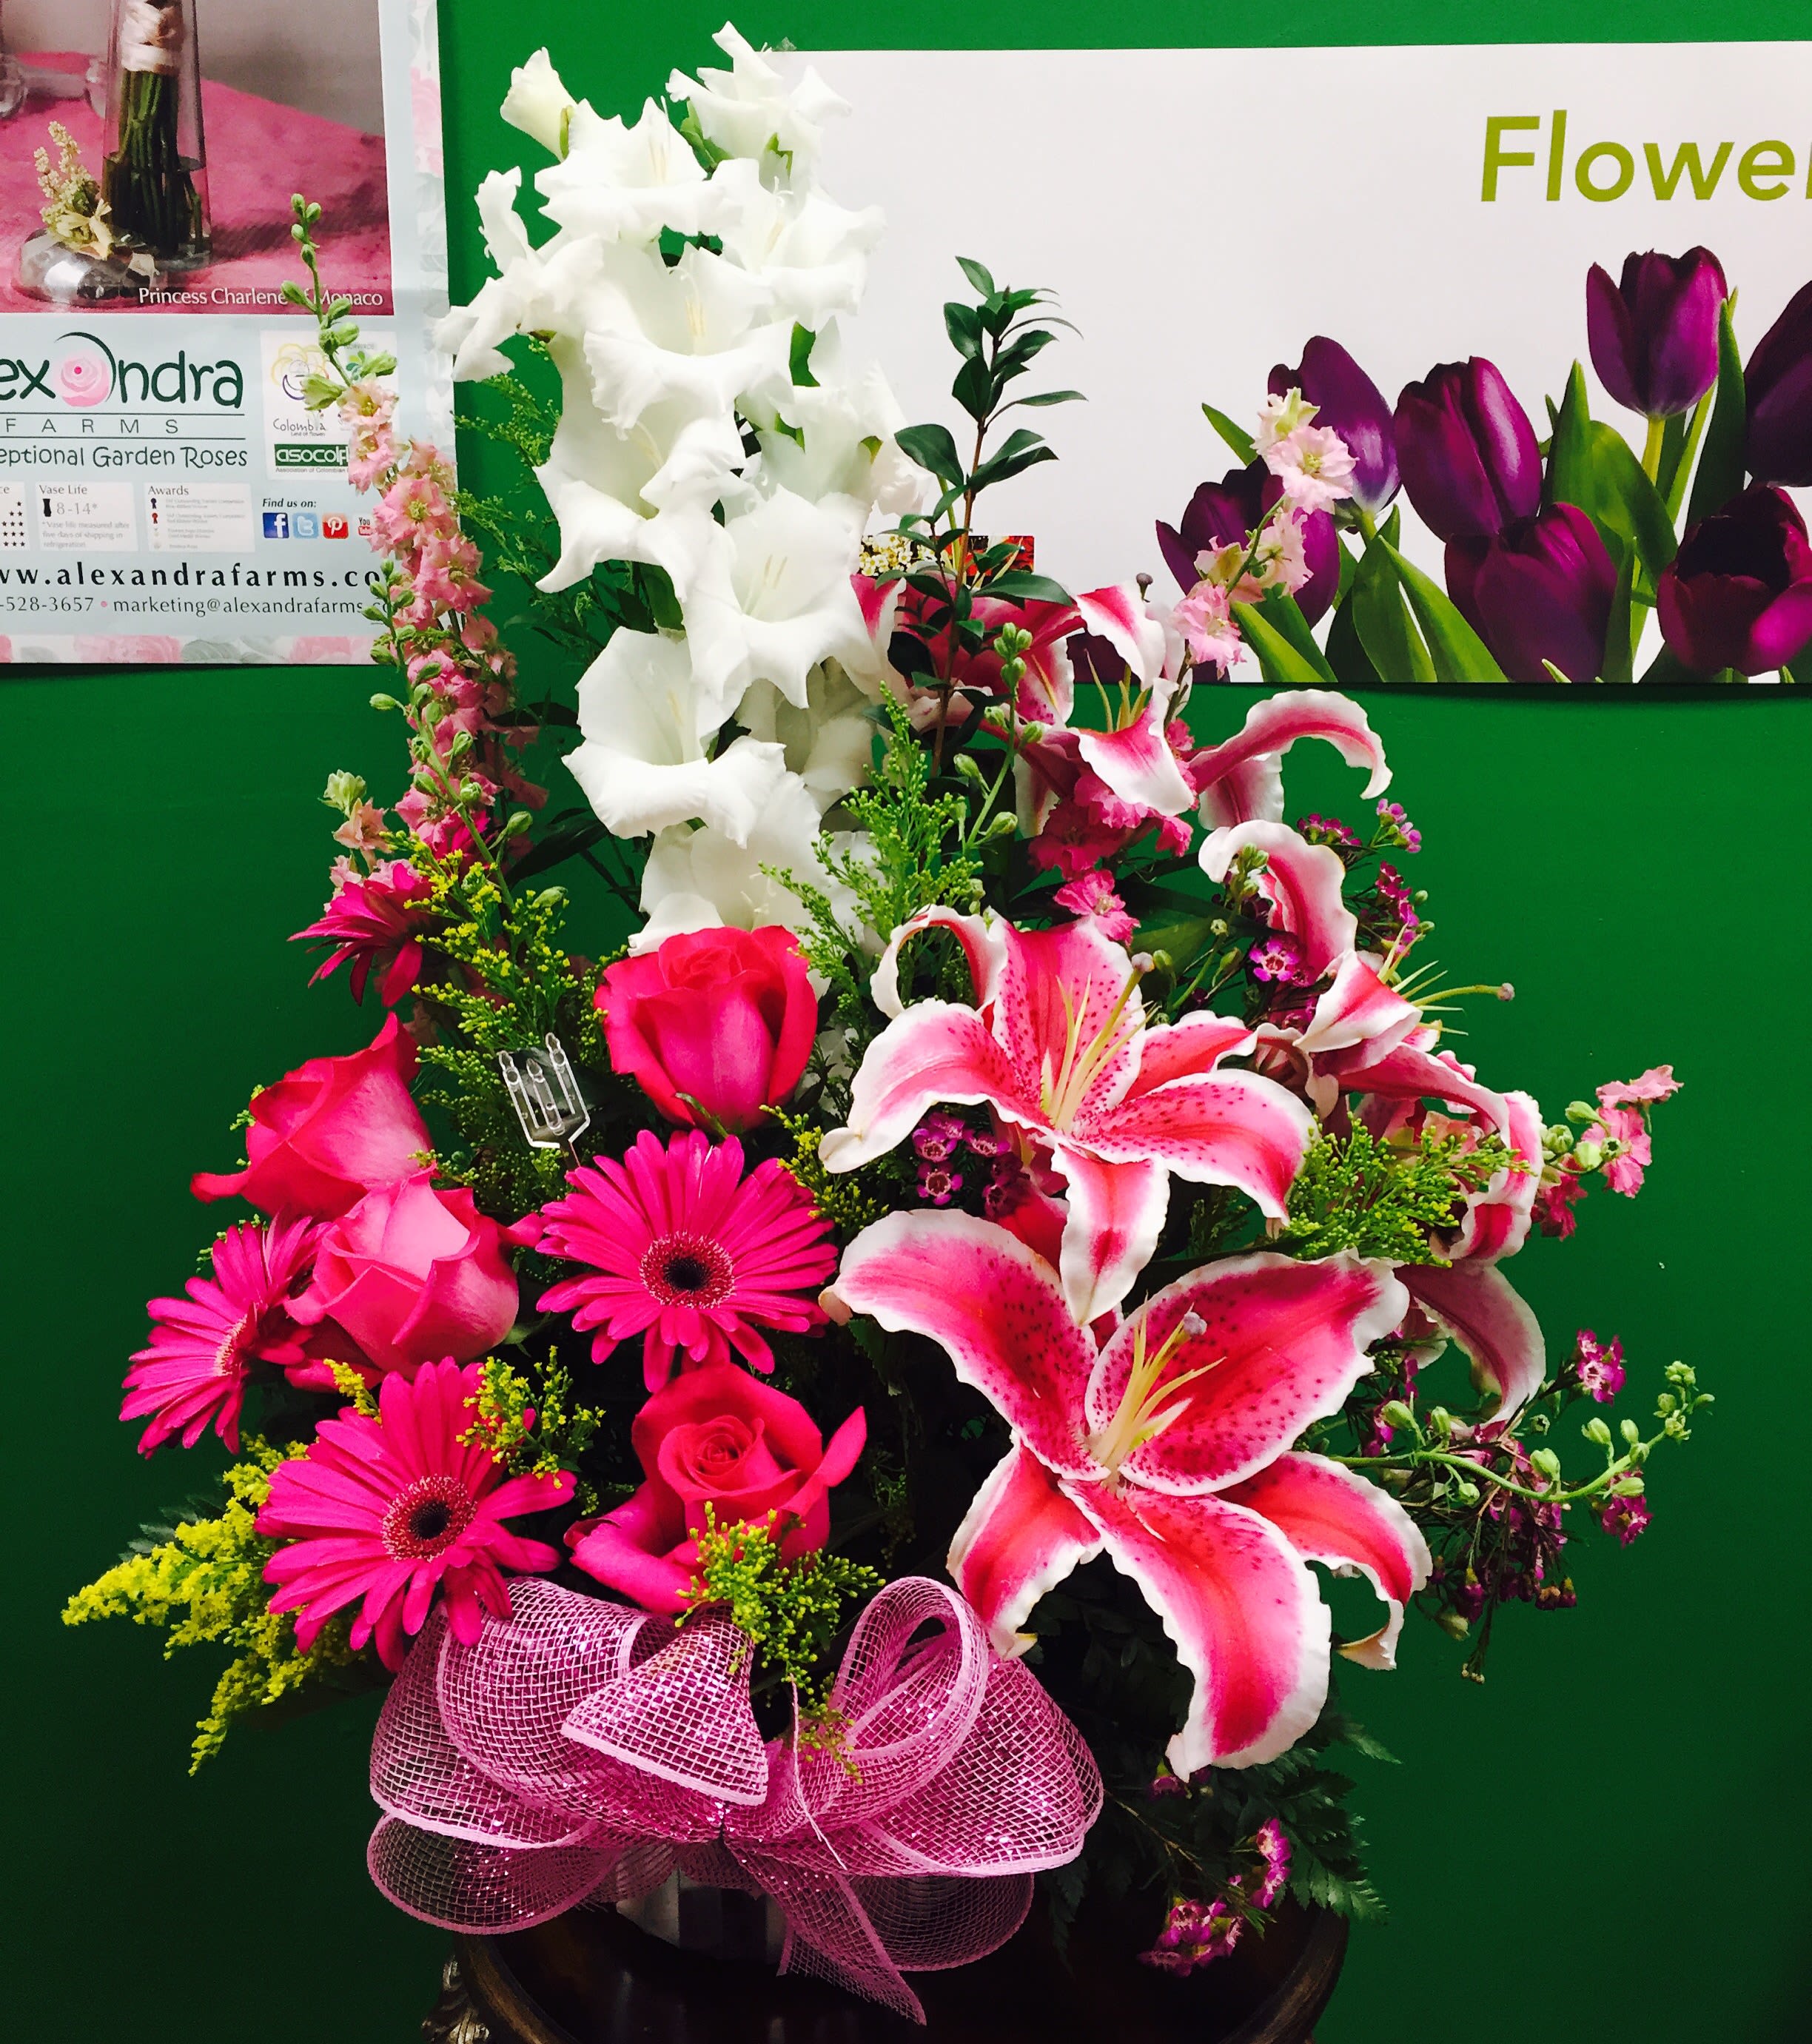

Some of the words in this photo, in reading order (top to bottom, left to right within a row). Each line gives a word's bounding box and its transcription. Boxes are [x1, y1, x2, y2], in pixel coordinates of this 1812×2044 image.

[1480, 110, 1812, 202] Flowe
[138, 287, 207, 304] Princess
[211, 287, 289, 304] Charlene
[0, 445, 84, 467] eptional
[93, 446, 175, 468] Garden
[180, 446, 248, 469] Roses
[39, 485, 64, 495] Vase
[68, 485, 88, 495] Life
[148, 485, 189, 495] Awards
[262, 497, 283, 508] Find
